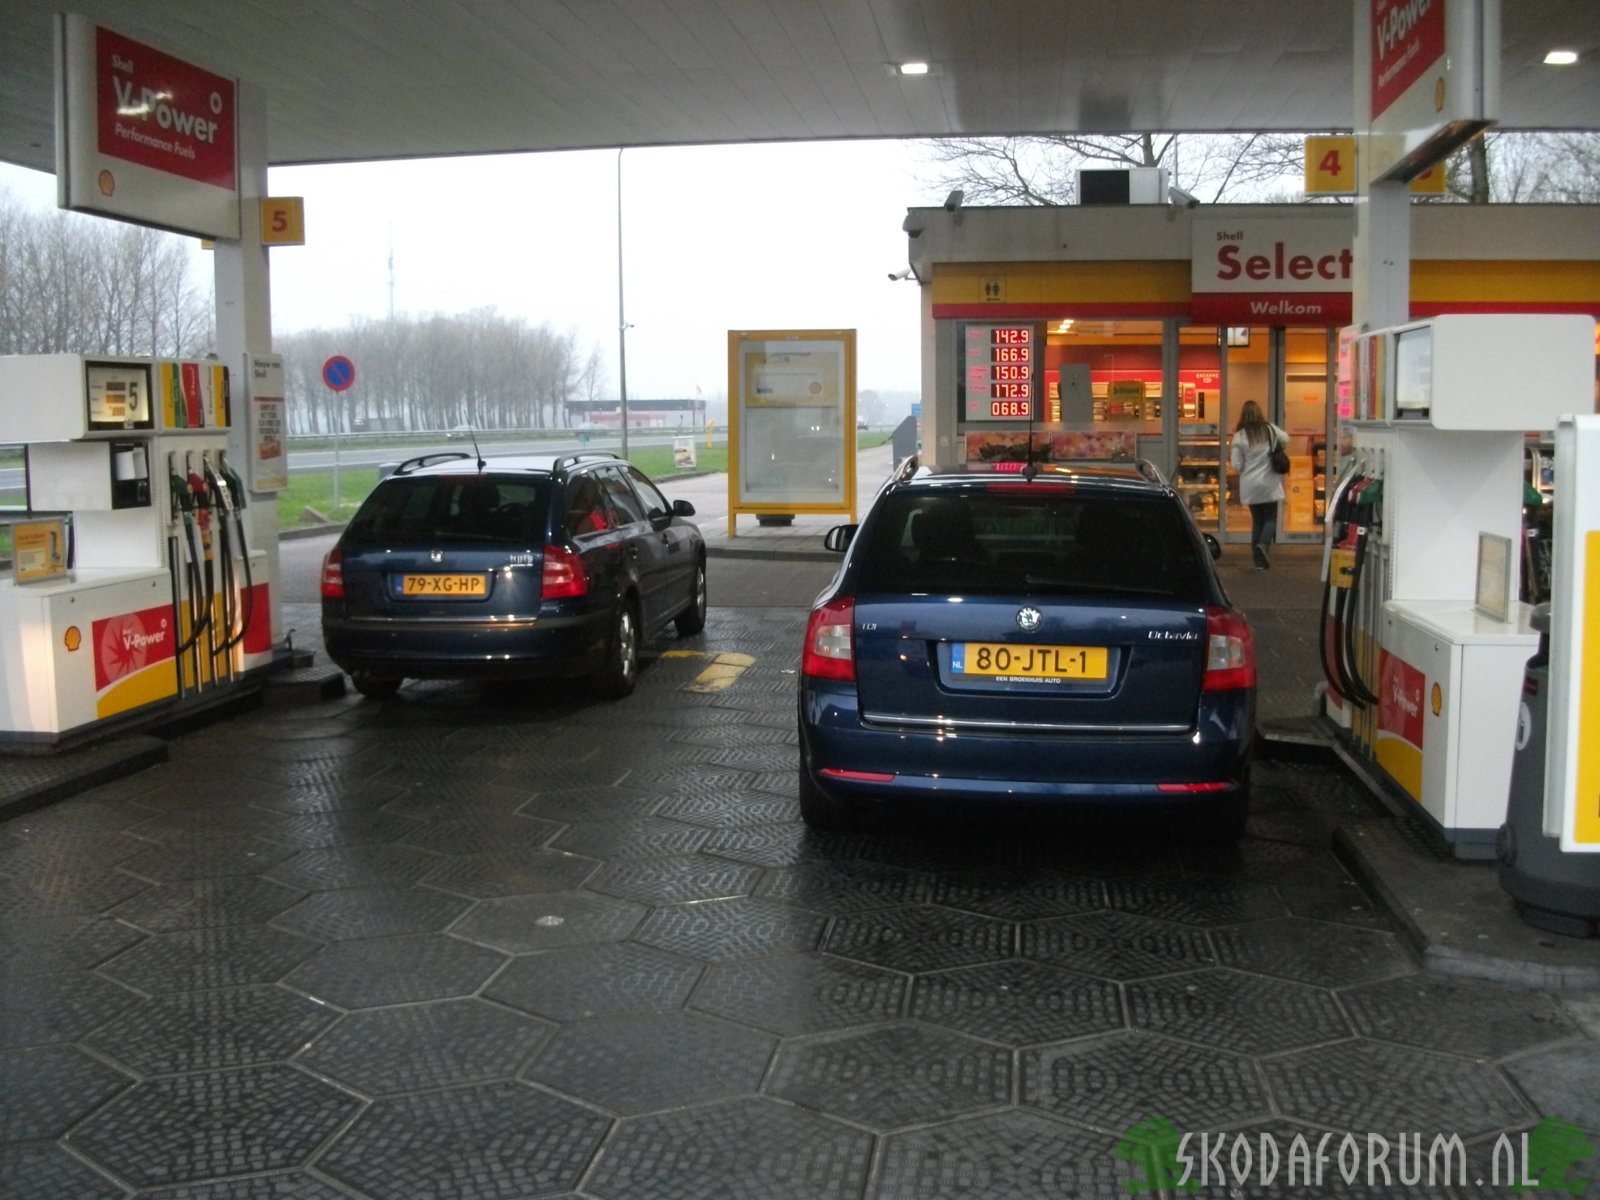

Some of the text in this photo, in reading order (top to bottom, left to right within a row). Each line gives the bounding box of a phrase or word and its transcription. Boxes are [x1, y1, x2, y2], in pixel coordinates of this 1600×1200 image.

[112, 55, 134, 74] Shell
[113, 76, 218, 144] V-Power
[115, 122, 196, 159] Performance Fuels
[1319, 150, 1341, 176] 4
[272, 211, 288, 232] 5
[1217, 231, 1243, 241] Shell
[1217, 242, 1353, 280] Select
[1251, 301, 1322, 314] Welkom
[995, 330, 1029, 344] 142.9
[995, 348, 1029, 362] 166.9
[995, 366, 1029, 380] 150.9
[129, 382, 138, 411] 5
[995, 384, 1029, 398] 172.9
[992, 402, 1029, 416] 068.9
[408, 578, 480, 591] 79-XG-HP
[123, 632, 165, 650] V-Power
[952, 661, 963, 669] NL
[976, 647, 1086, 673] 80-JTL-1
